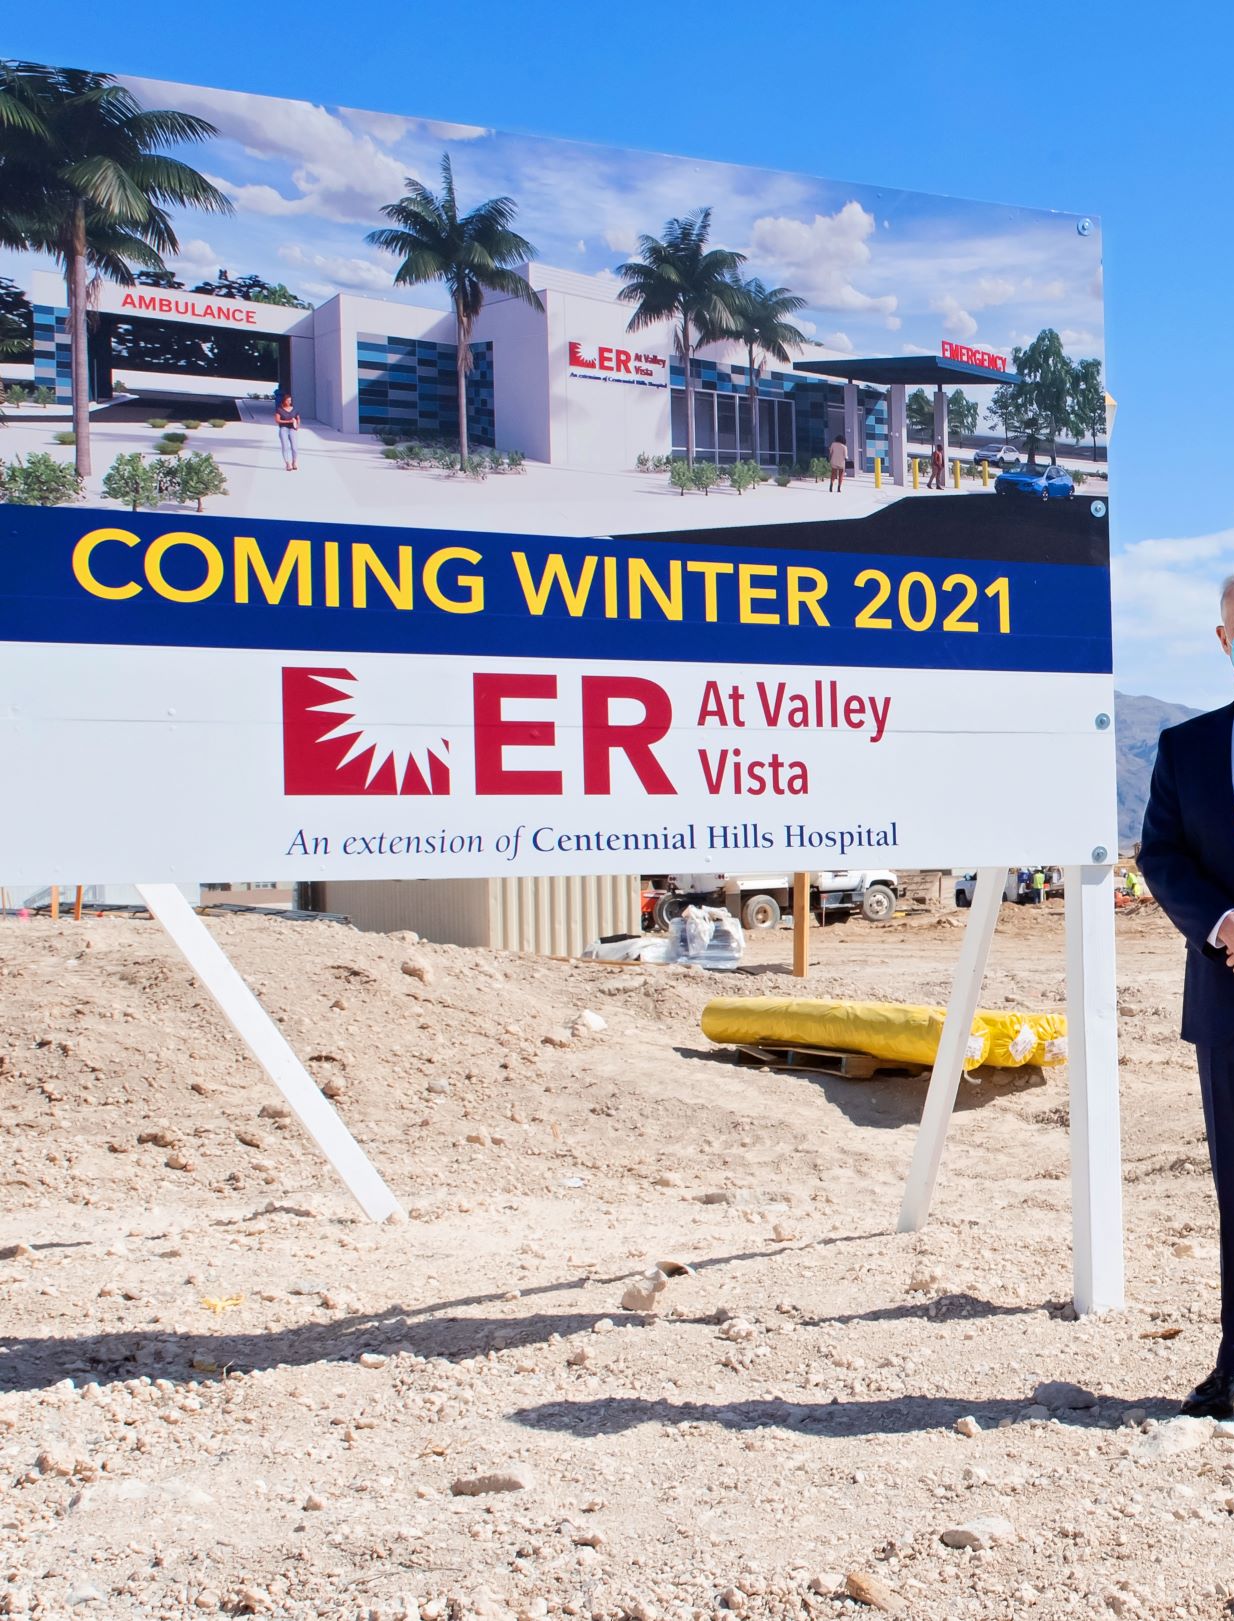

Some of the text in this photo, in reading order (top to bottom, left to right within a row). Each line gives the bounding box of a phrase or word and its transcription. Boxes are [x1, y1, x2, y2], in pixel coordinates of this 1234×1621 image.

[121, 293, 257, 324] AMBULANCE
[598, 346, 632, 374] ER
[941, 340, 1007, 372] EMERGENCY
[72, 528, 1010, 633] COMING WINTER 2021
[697, 680, 892, 743] At Valley
[473, 672, 678, 796] ER
[698, 748, 810, 796] Vista
[285, 821, 899, 861] An extension of Centennial Hills Hospital
